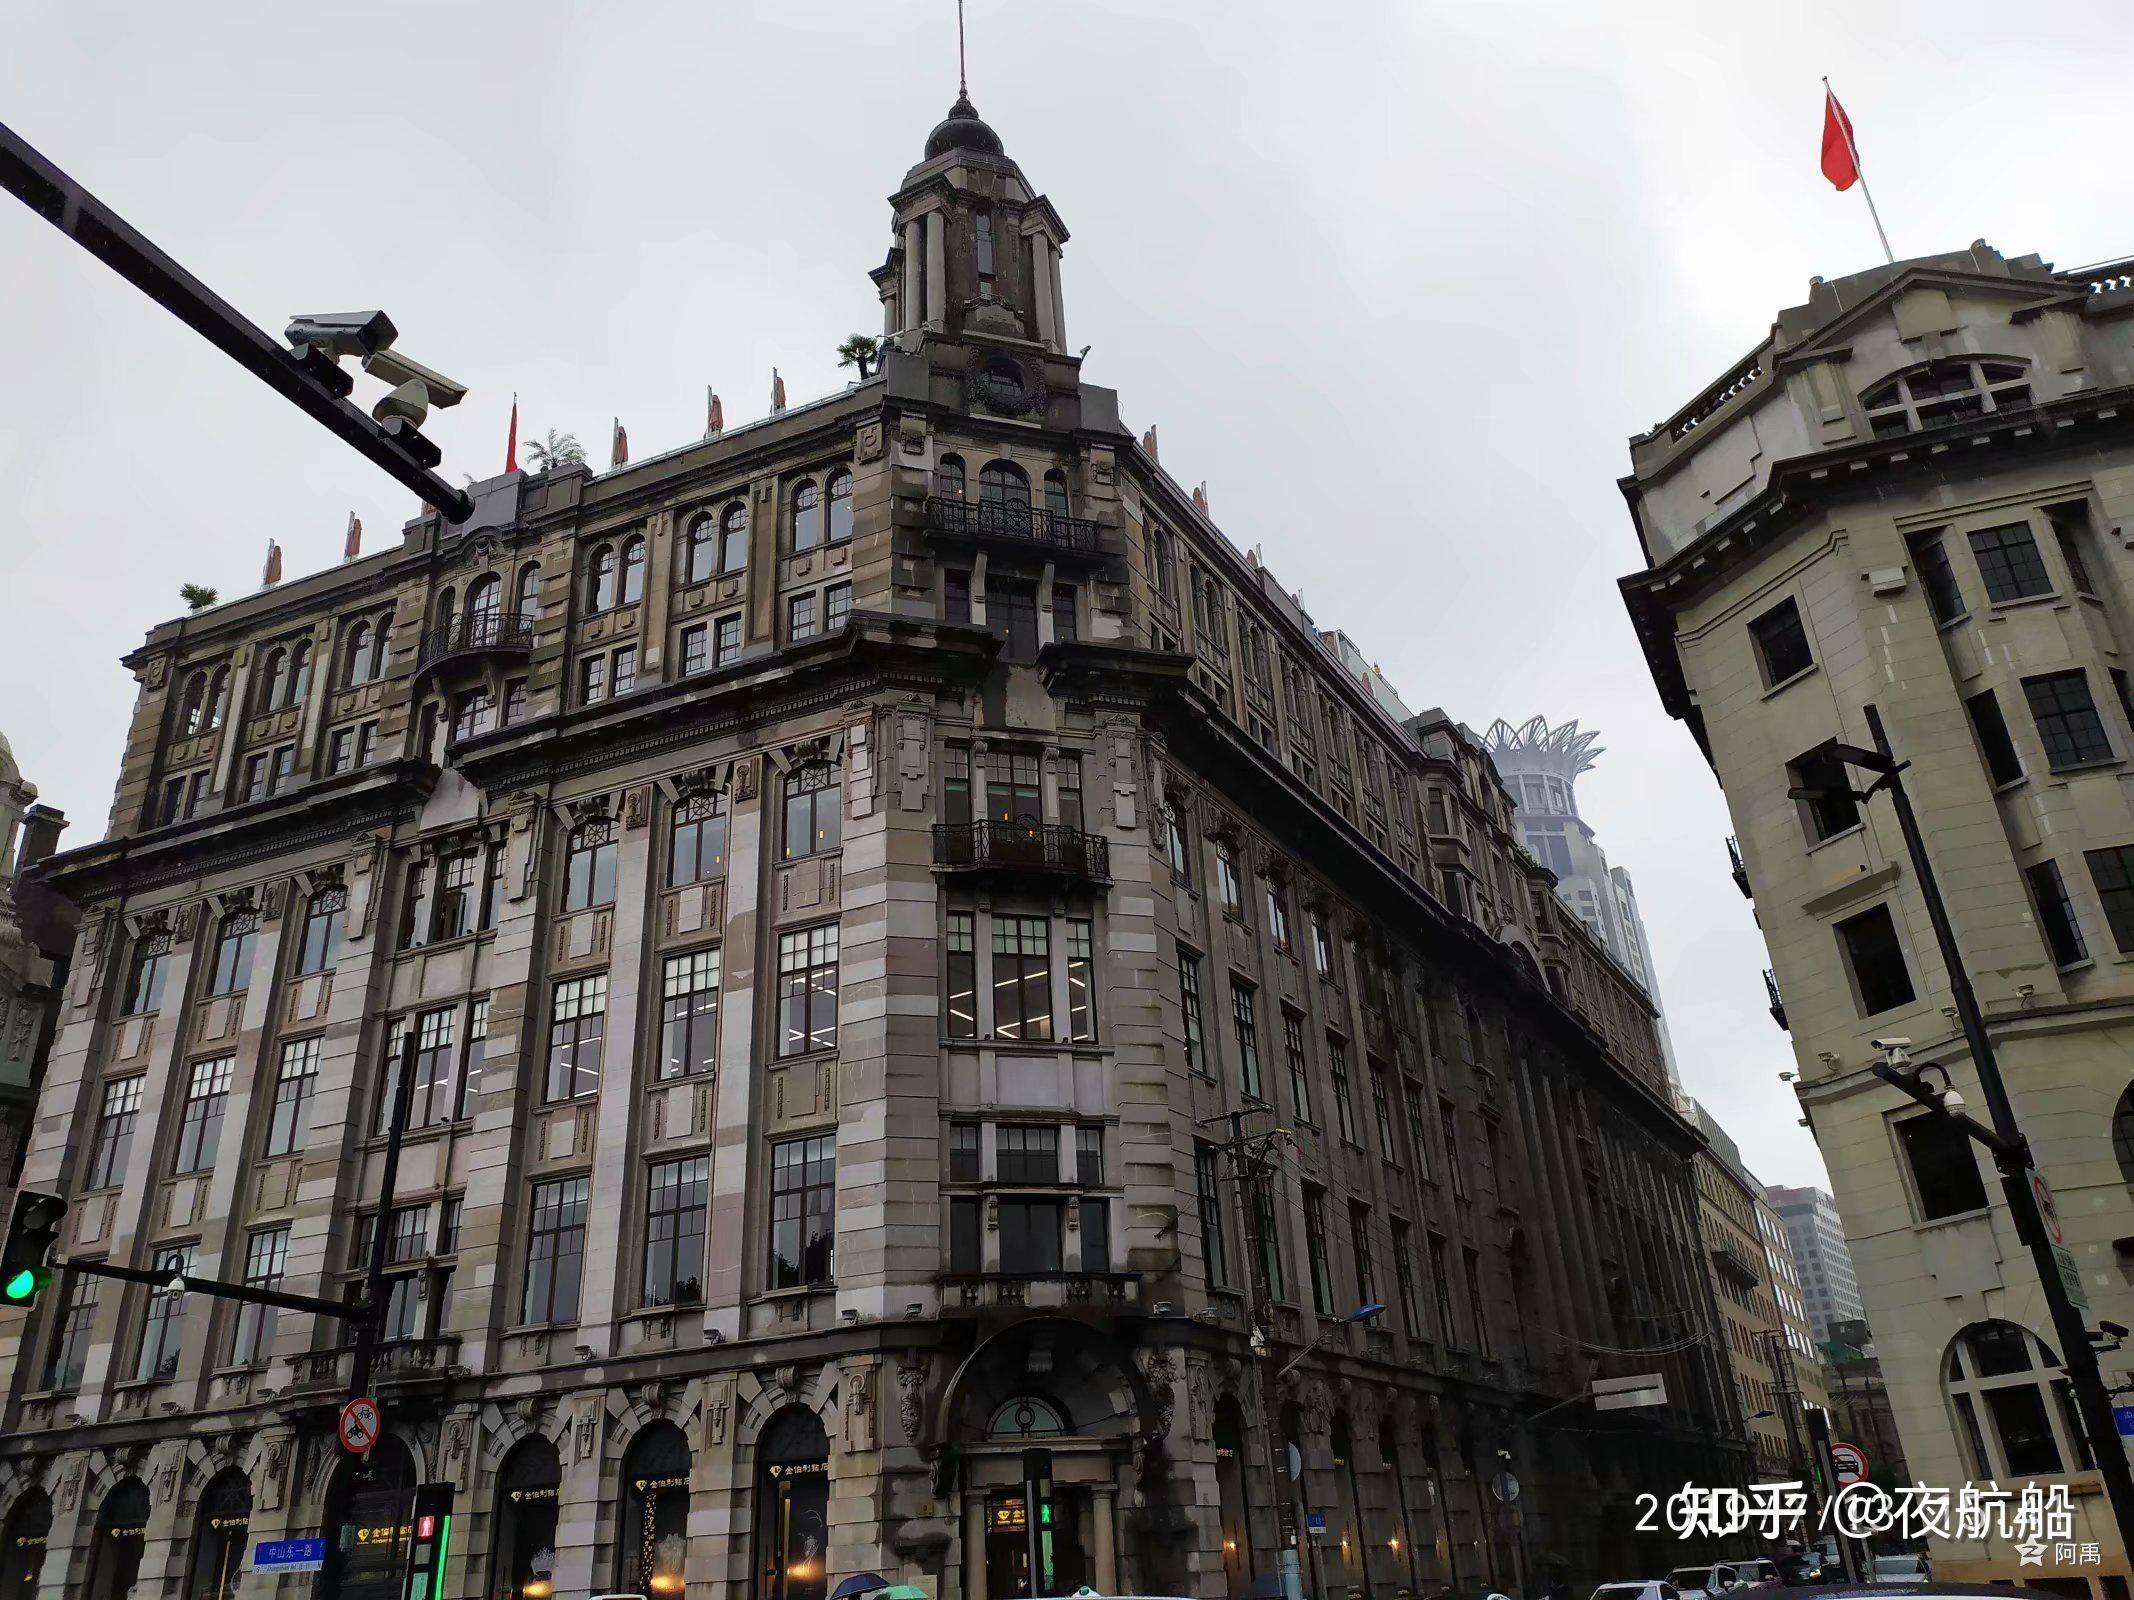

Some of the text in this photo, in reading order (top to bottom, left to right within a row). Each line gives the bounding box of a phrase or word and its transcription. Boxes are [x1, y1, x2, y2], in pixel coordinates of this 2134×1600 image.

[268, 1543, 313, 1559] 中山东一路
